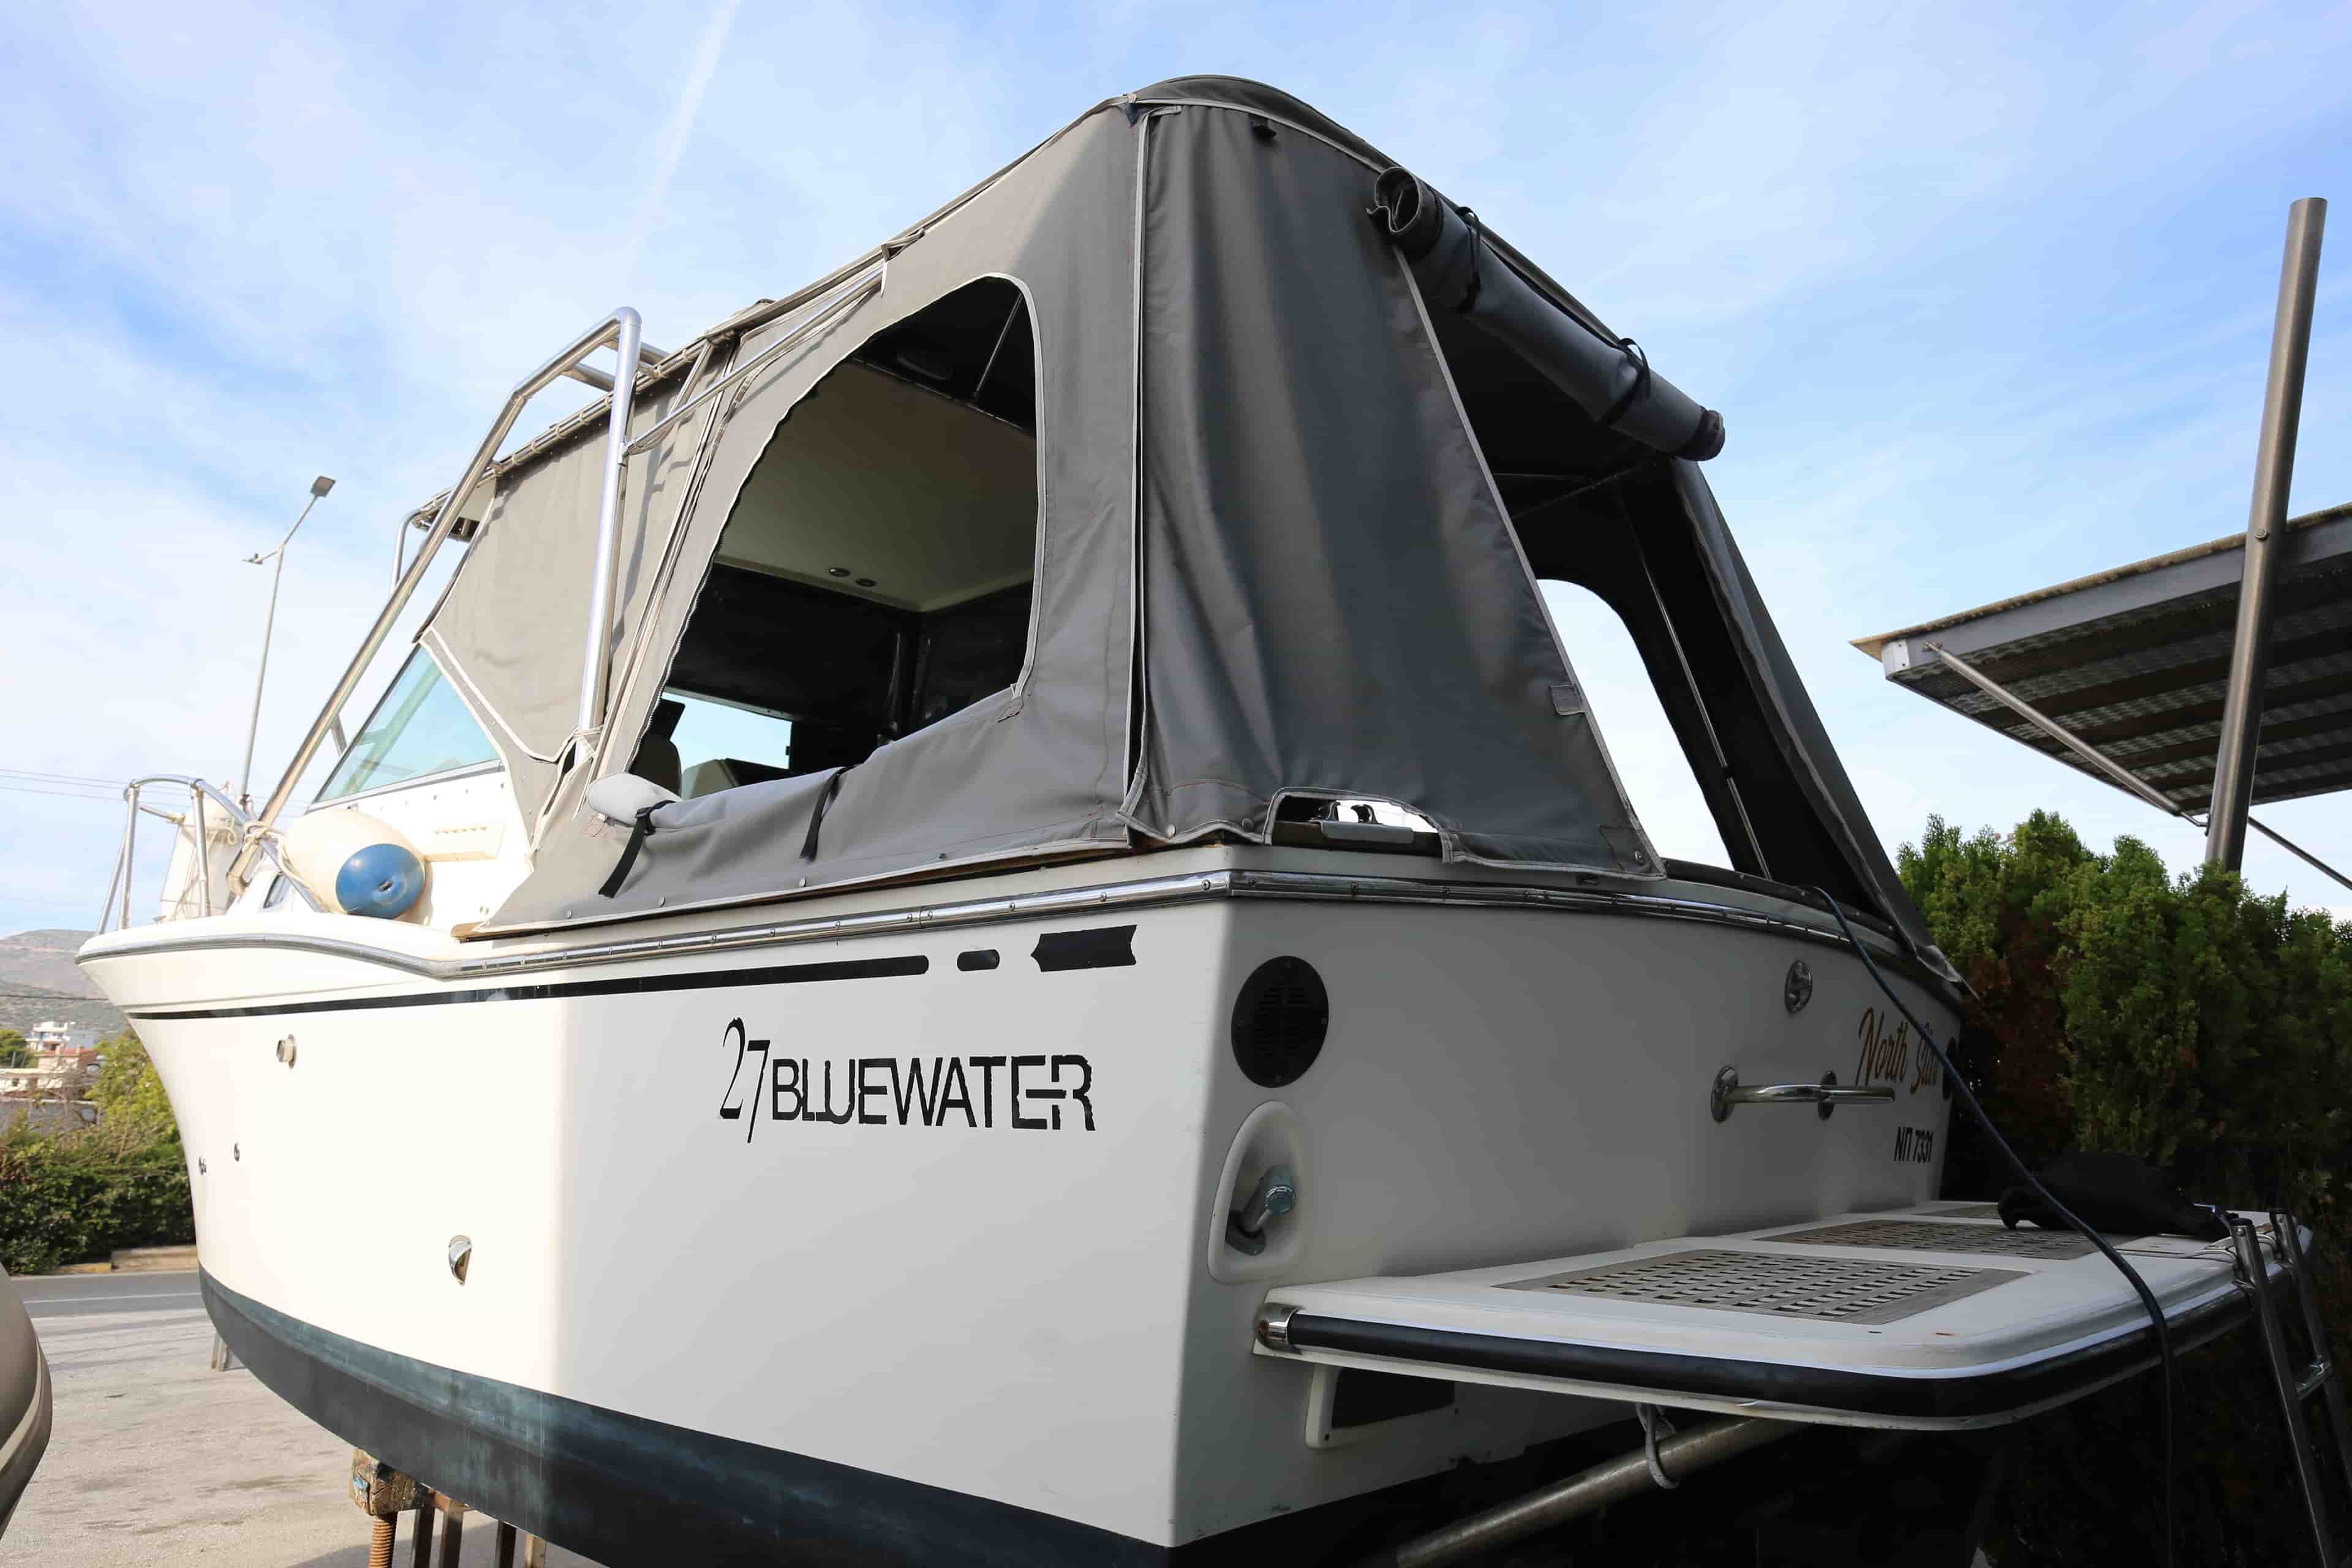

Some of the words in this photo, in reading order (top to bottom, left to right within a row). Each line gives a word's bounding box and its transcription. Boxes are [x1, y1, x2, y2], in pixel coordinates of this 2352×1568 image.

[719, 1016, 771, 1144] 27
[772, 1054, 1096, 1131] BLUEWATER
[1855, 1007, 1908, 1087] North
